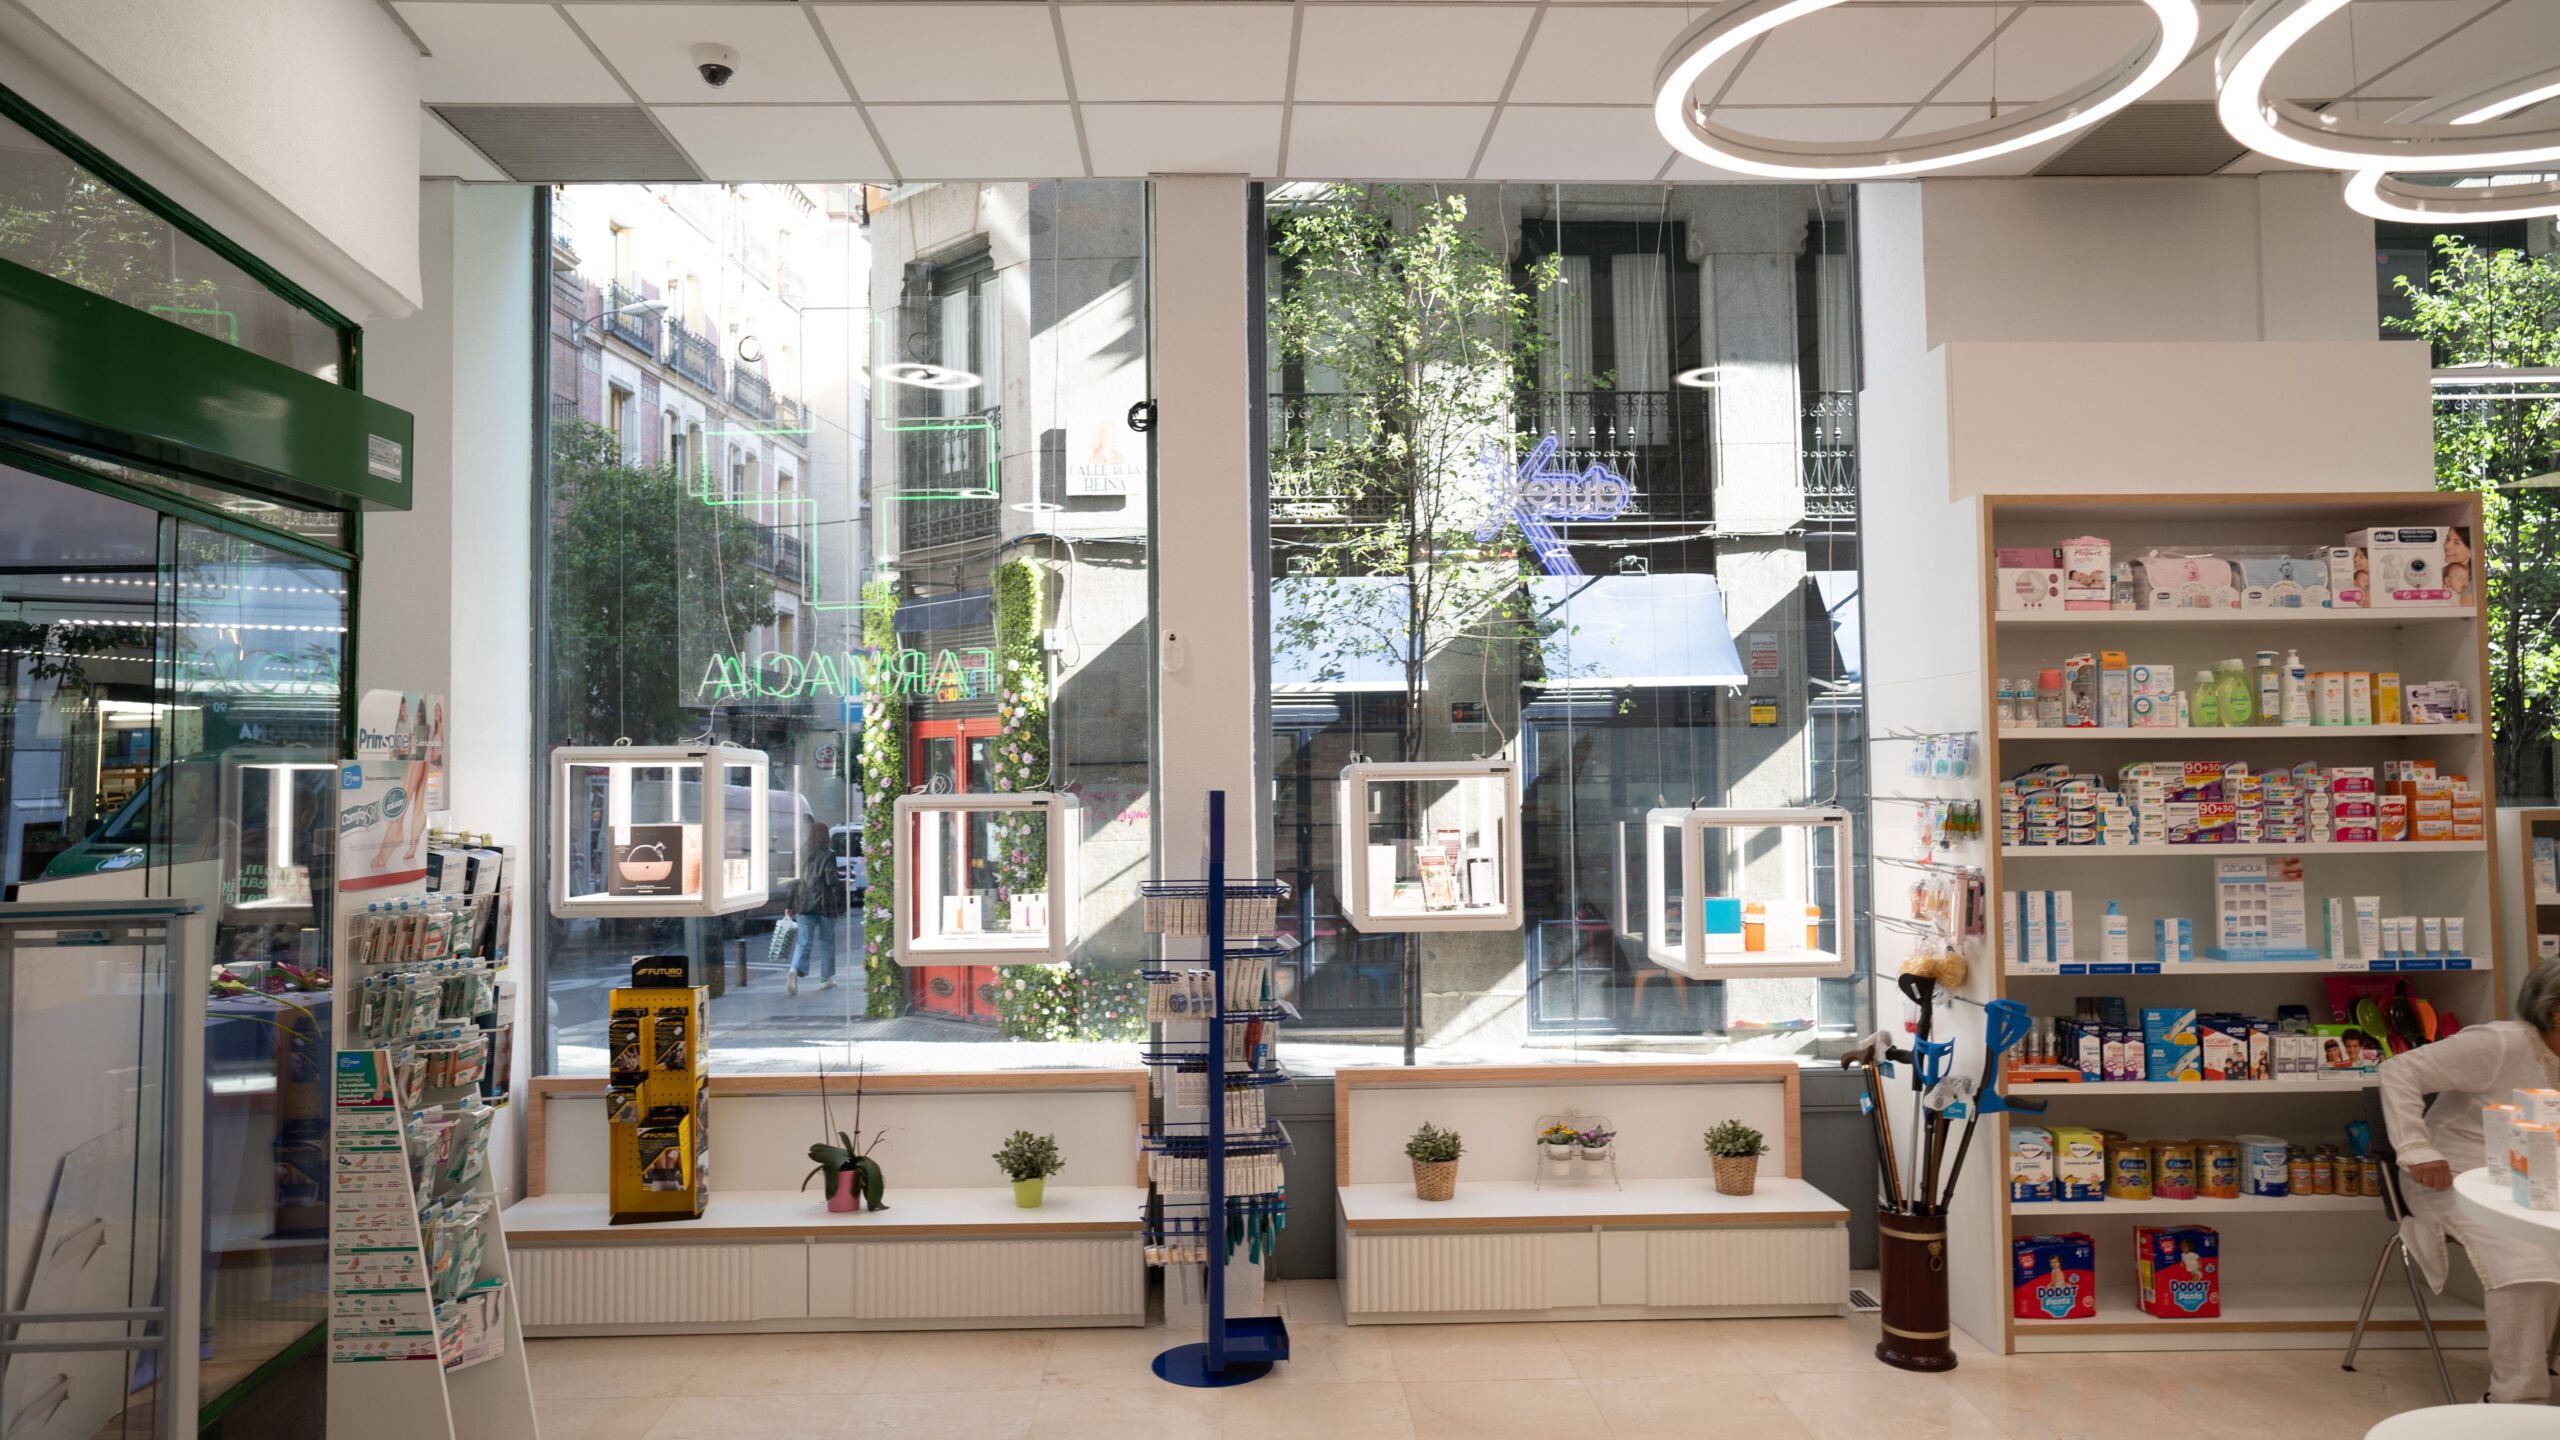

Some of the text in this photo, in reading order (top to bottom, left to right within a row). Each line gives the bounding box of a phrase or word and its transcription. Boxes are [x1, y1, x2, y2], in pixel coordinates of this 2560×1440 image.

[1084, 477, 1126, 491] REINA
[2185, 763, 2220, 773] 90+30
[2200, 804, 2235, 814] 90+30
[2171, 1280, 2210, 1291] DODOT
[2038, 1286, 2078, 1298] DODOT
